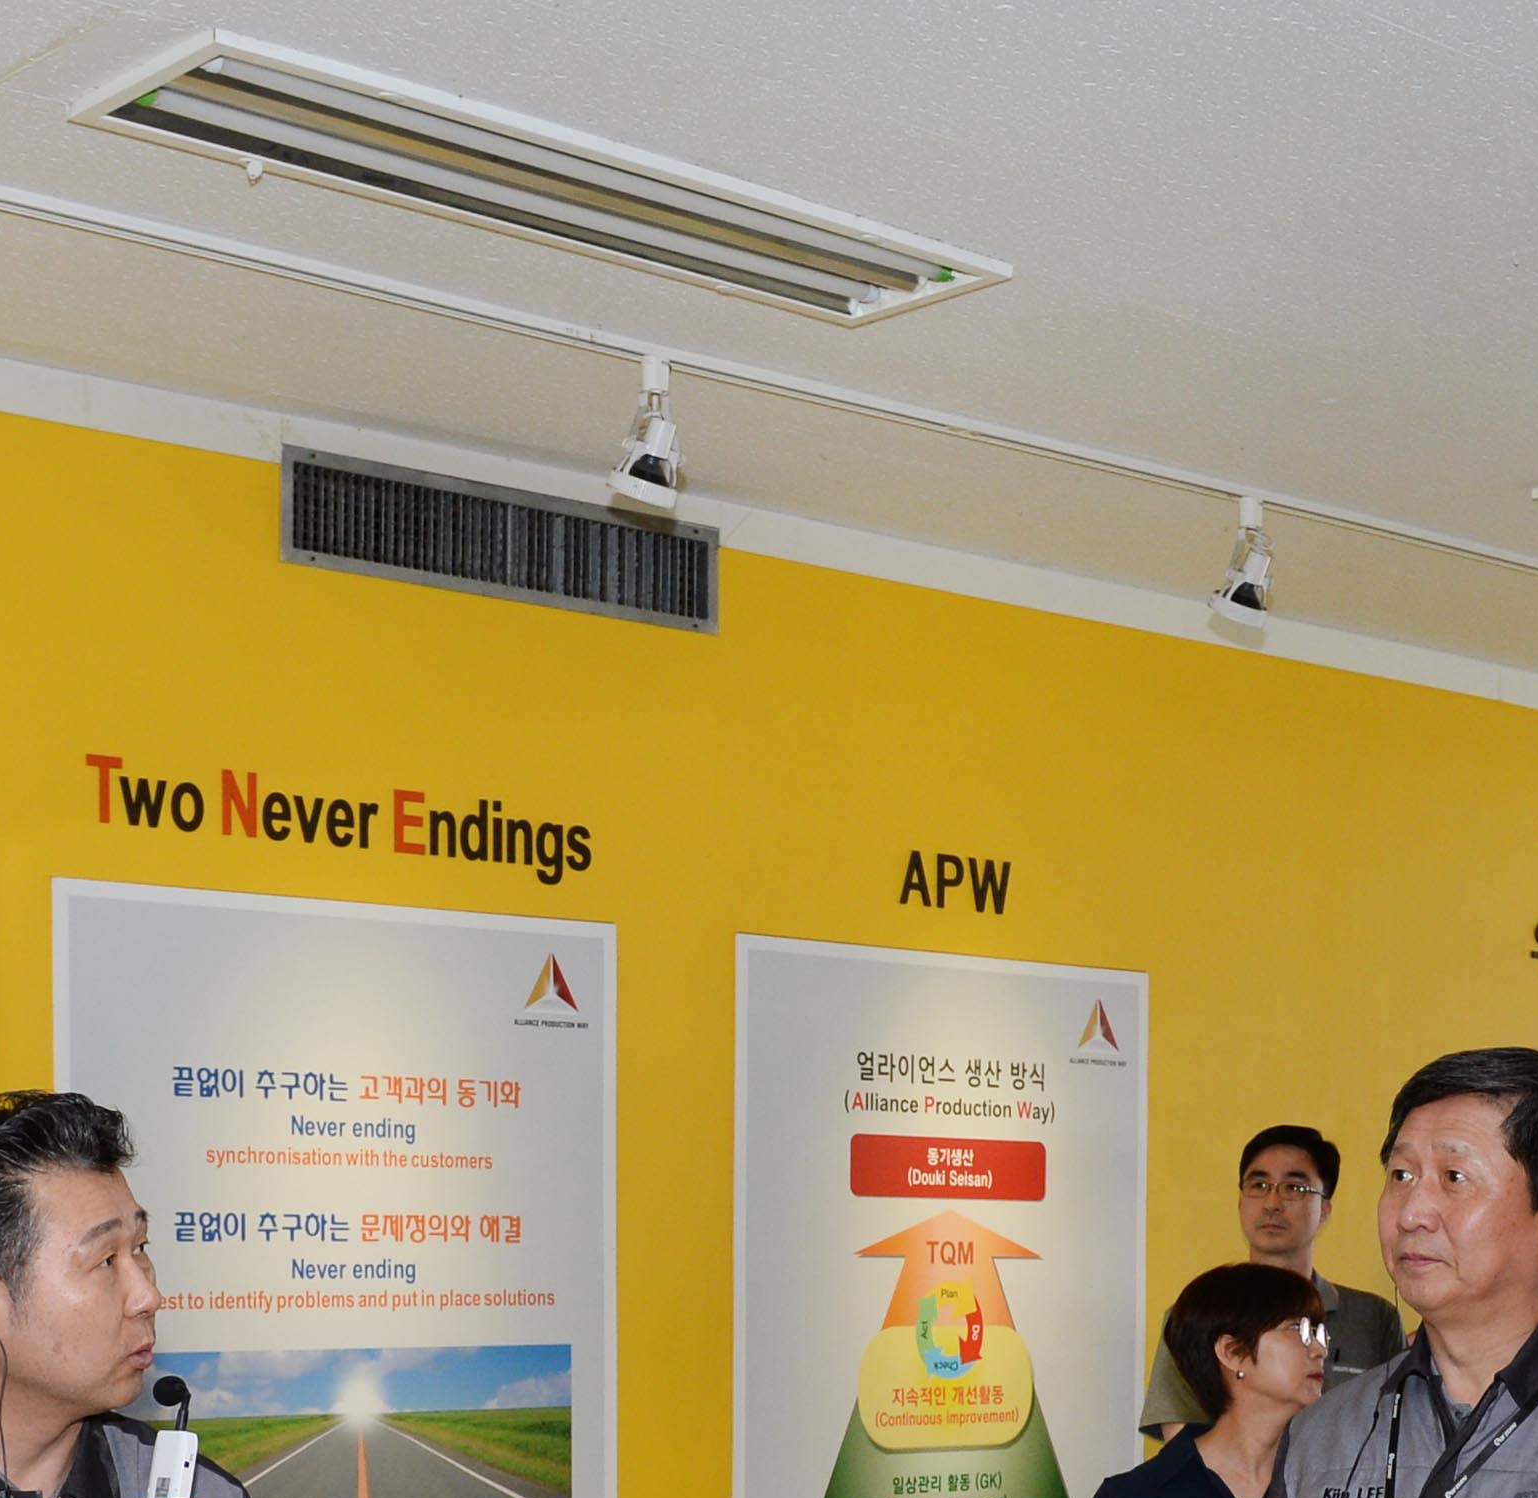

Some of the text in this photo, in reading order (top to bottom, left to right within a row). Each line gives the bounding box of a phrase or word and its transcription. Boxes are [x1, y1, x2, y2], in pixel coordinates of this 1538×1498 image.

[85, 753, 592, 885] Two Never Endings
[899, 850, 1011, 915] APW
[514, 1018, 539, 1027] ALLIANCE
[540, 1019, 575, 1029] PRODUCTION
[856, 1050, 1046, 1092] 얼라이언스 생산 방식
[172, 1065, 521, 1109] 끝없이 추구하는 고객과의 동기화
[844, 1089, 1056, 1124] (Alliance Production Way)
[291, 1115, 416, 1144] Never ending
[205, 1145, 493, 1170] synchronisation with the customers
[926, 1147, 974, 1168] 동기생산
[907, 1169, 993, 1190] (Douki Seisan)
[173, 1211, 522, 1244] 끝없이 추구하는 문제정의와 해결
[926, 1240, 974, 1266] TQM
[291, 1259, 416, 1285] Never ending
[158, 1288, 555, 1315] est to identify problems and put in place solutions
[941, 1288, 958, 1298] Plan
[972, 1324, 980, 1341] Do
[933, 1361, 959, 1371] Check
[892, 1384, 1004, 1408] 지속적인 개선활동
[875, 1408, 1020, 1429] (Continuous improvement)
[892, 1470, 1002, 1496] 일상관리 활동 (GK)
